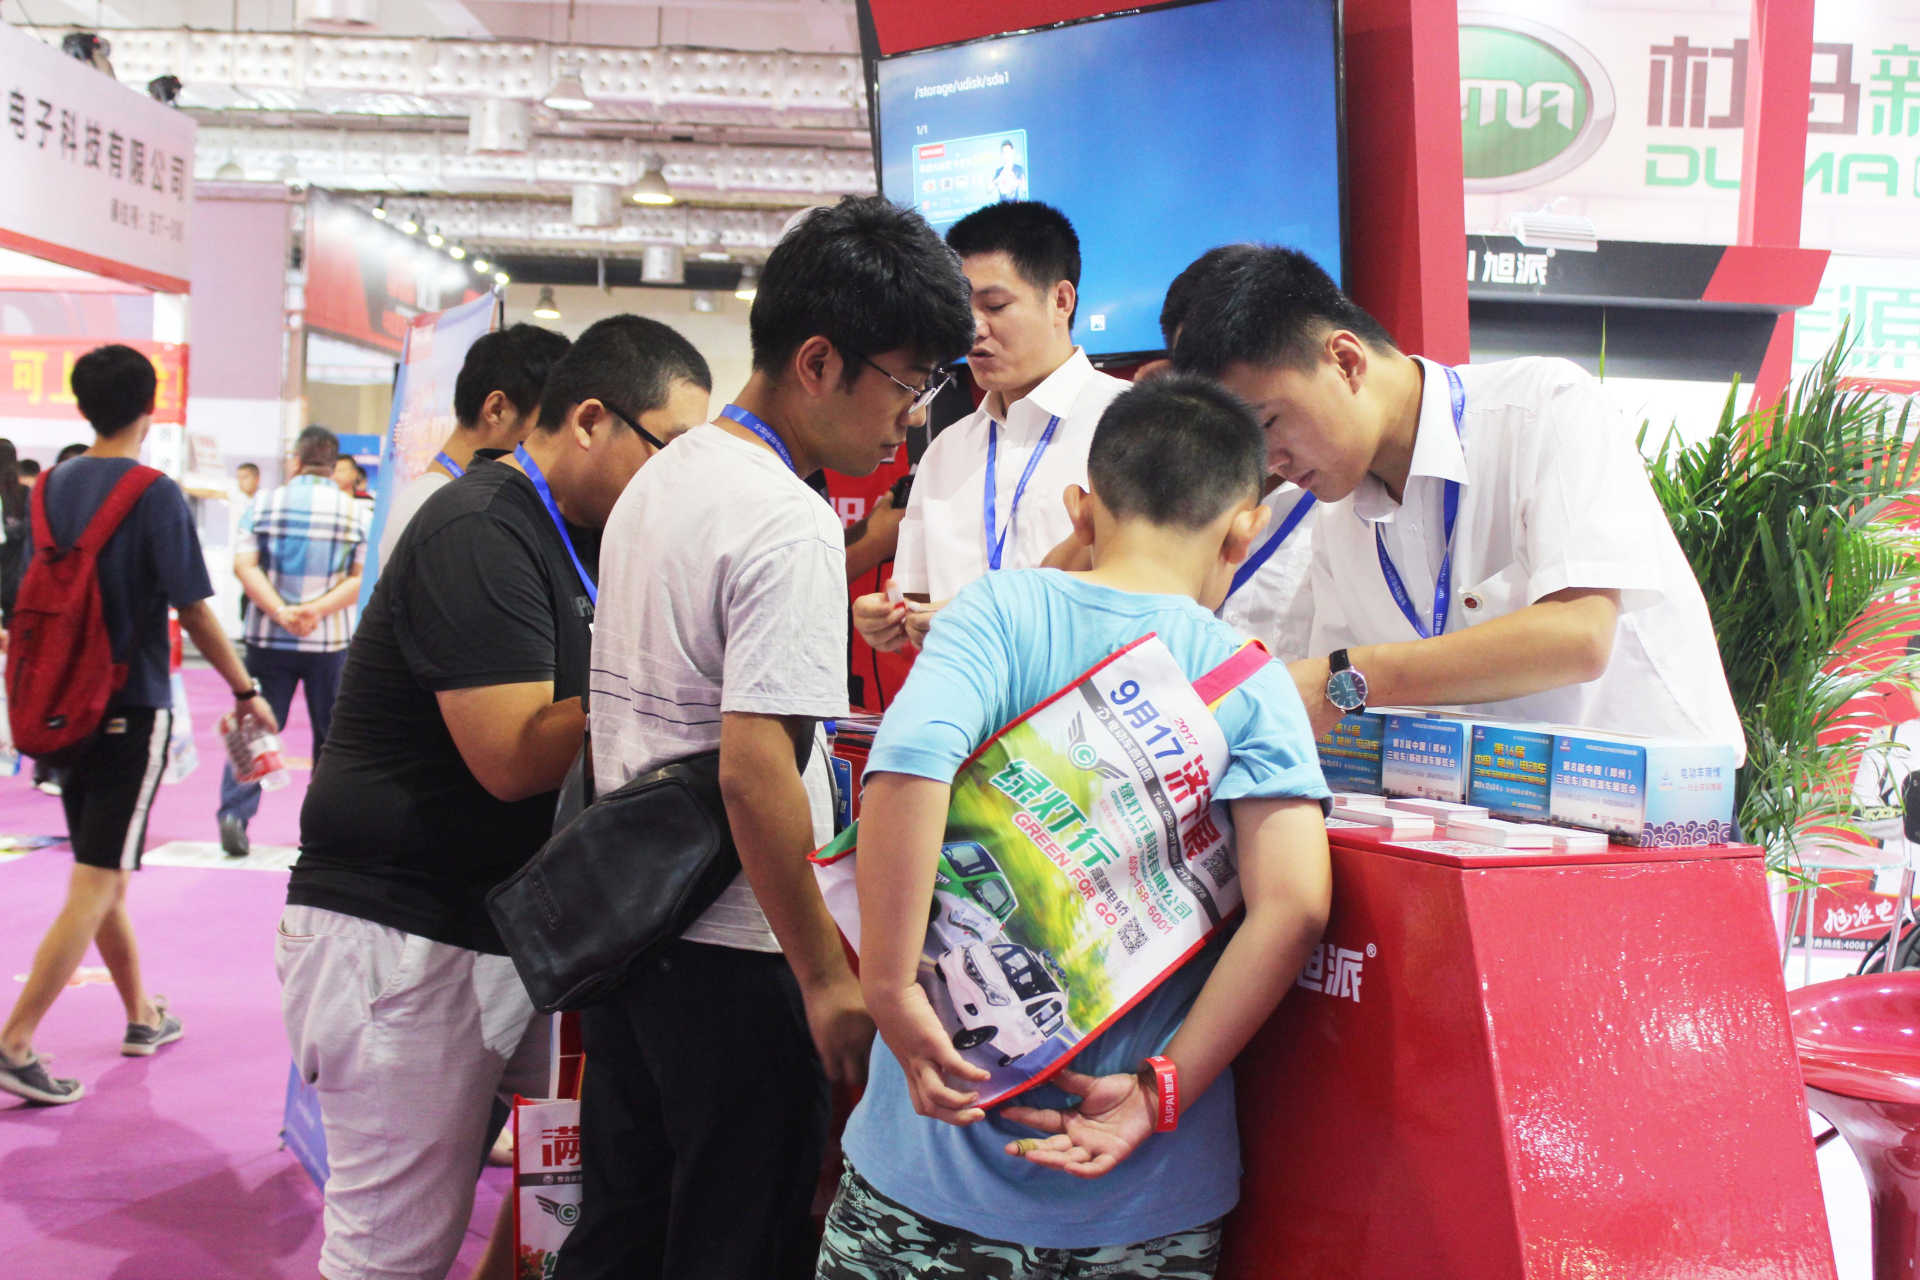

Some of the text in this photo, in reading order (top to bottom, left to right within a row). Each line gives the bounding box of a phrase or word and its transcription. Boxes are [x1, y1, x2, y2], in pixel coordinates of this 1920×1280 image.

[914, 72, 1009, 100] /storage/udisk/sda1
[9, 90, 185, 201] 电子科技有限公司
[916, 125, 928, 136] 1/1
[1482, 250, 1548, 285] 旭派
[1109, 679, 1185, 760] 9月17
[1173, 716, 1199, 747] 2017
[990, 759, 1121, 868] 绿灯行
[1163, 753, 1223, 861] 济宁展
[1012, 812, 1119, 927] GREEN FOR GO
